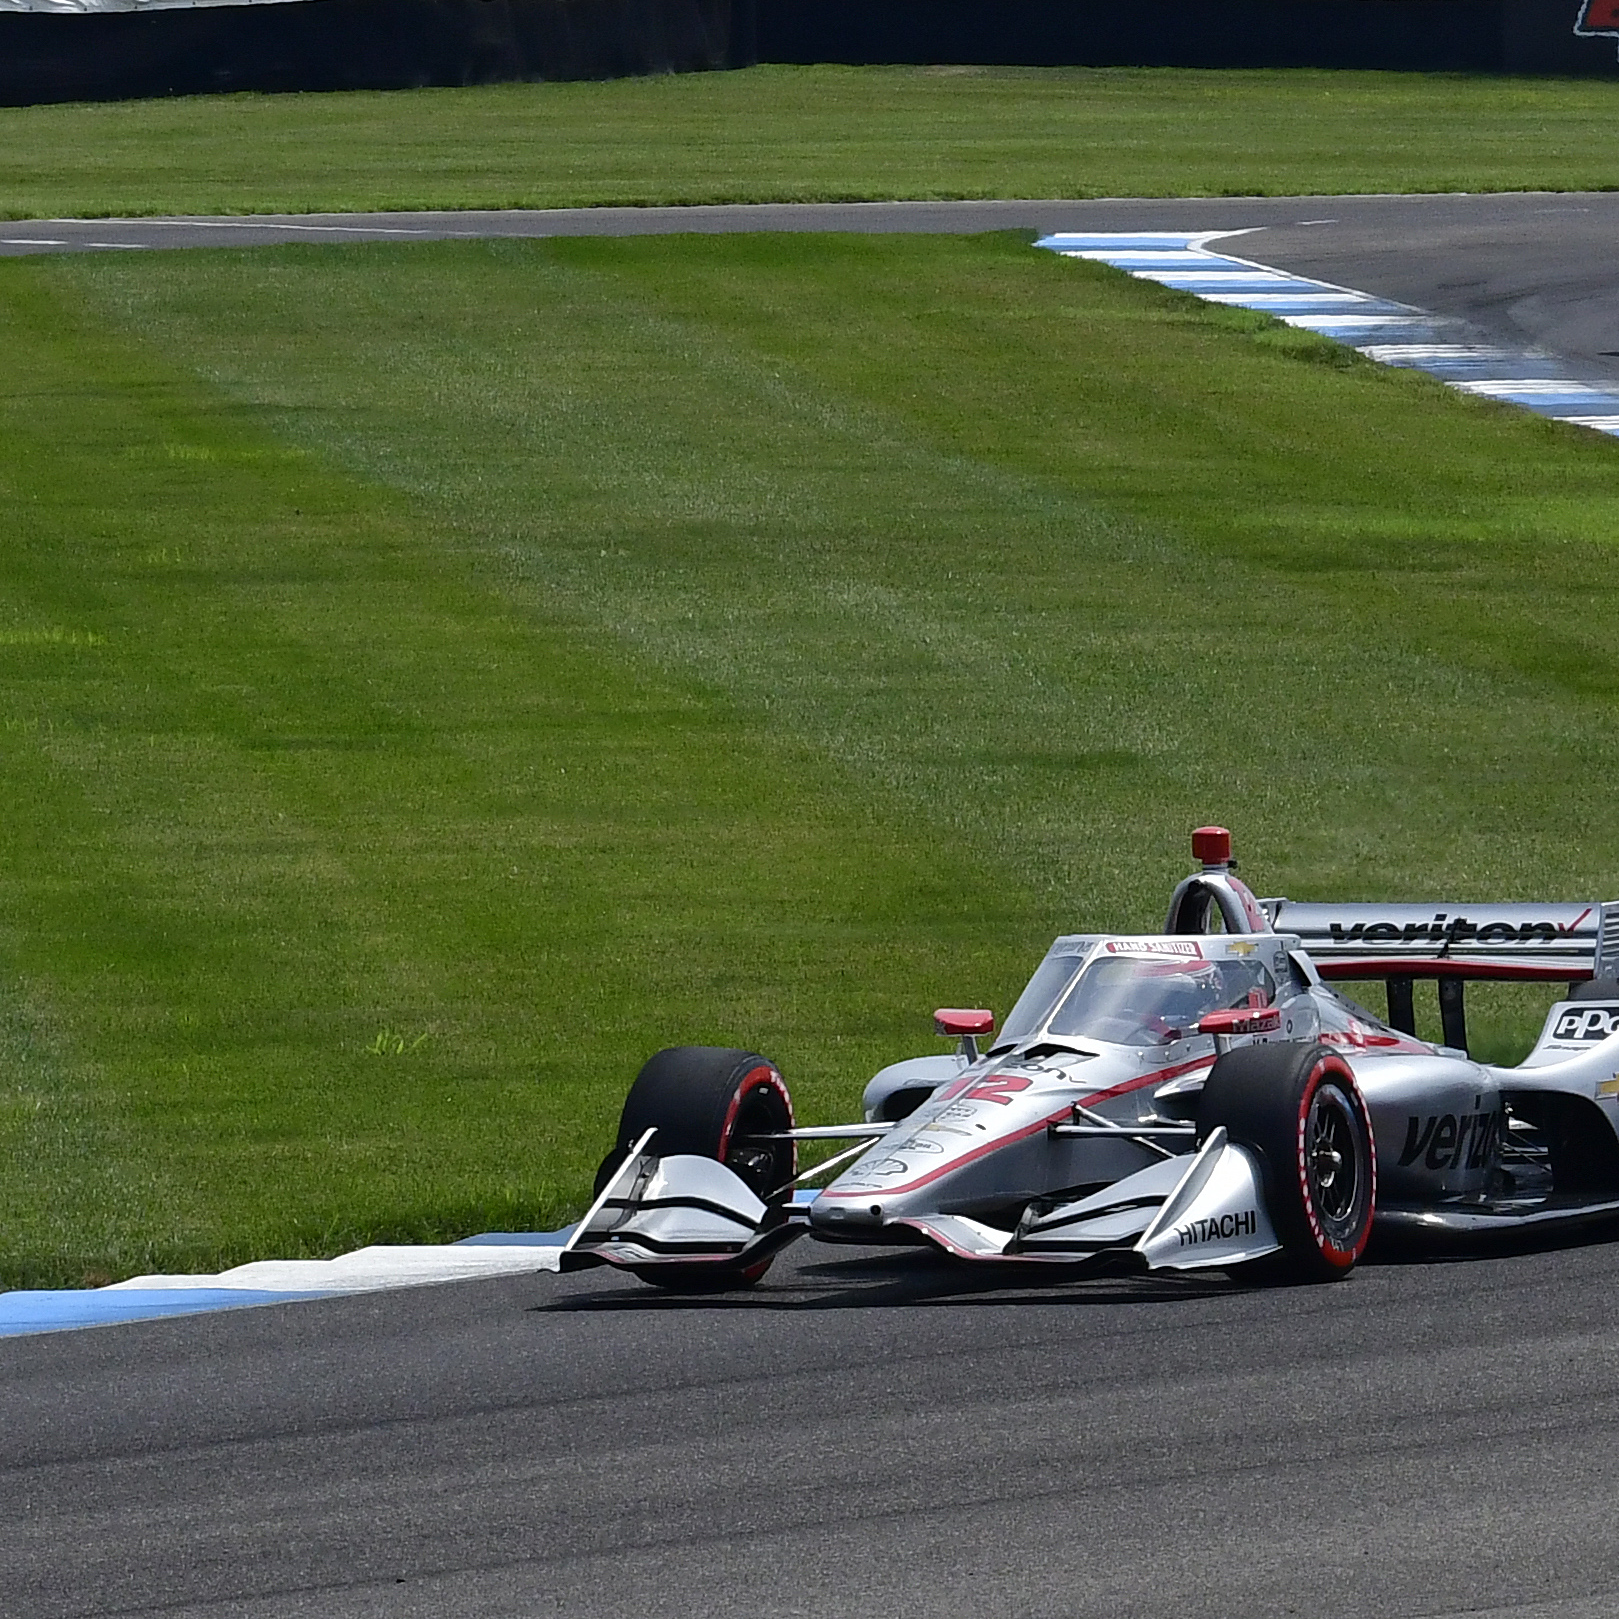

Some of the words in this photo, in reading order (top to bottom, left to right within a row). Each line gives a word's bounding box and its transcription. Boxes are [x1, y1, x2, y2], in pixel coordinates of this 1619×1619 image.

[1329, 914, 1564, 946] verizon
[1113, 942, 1144, 953] HAND
[1149, 942, 1197, 956] SANITIZER
[1232, 1018, 1281, 1033] Mazak
[1178, 1210, 1257, 1247] HITACHI
